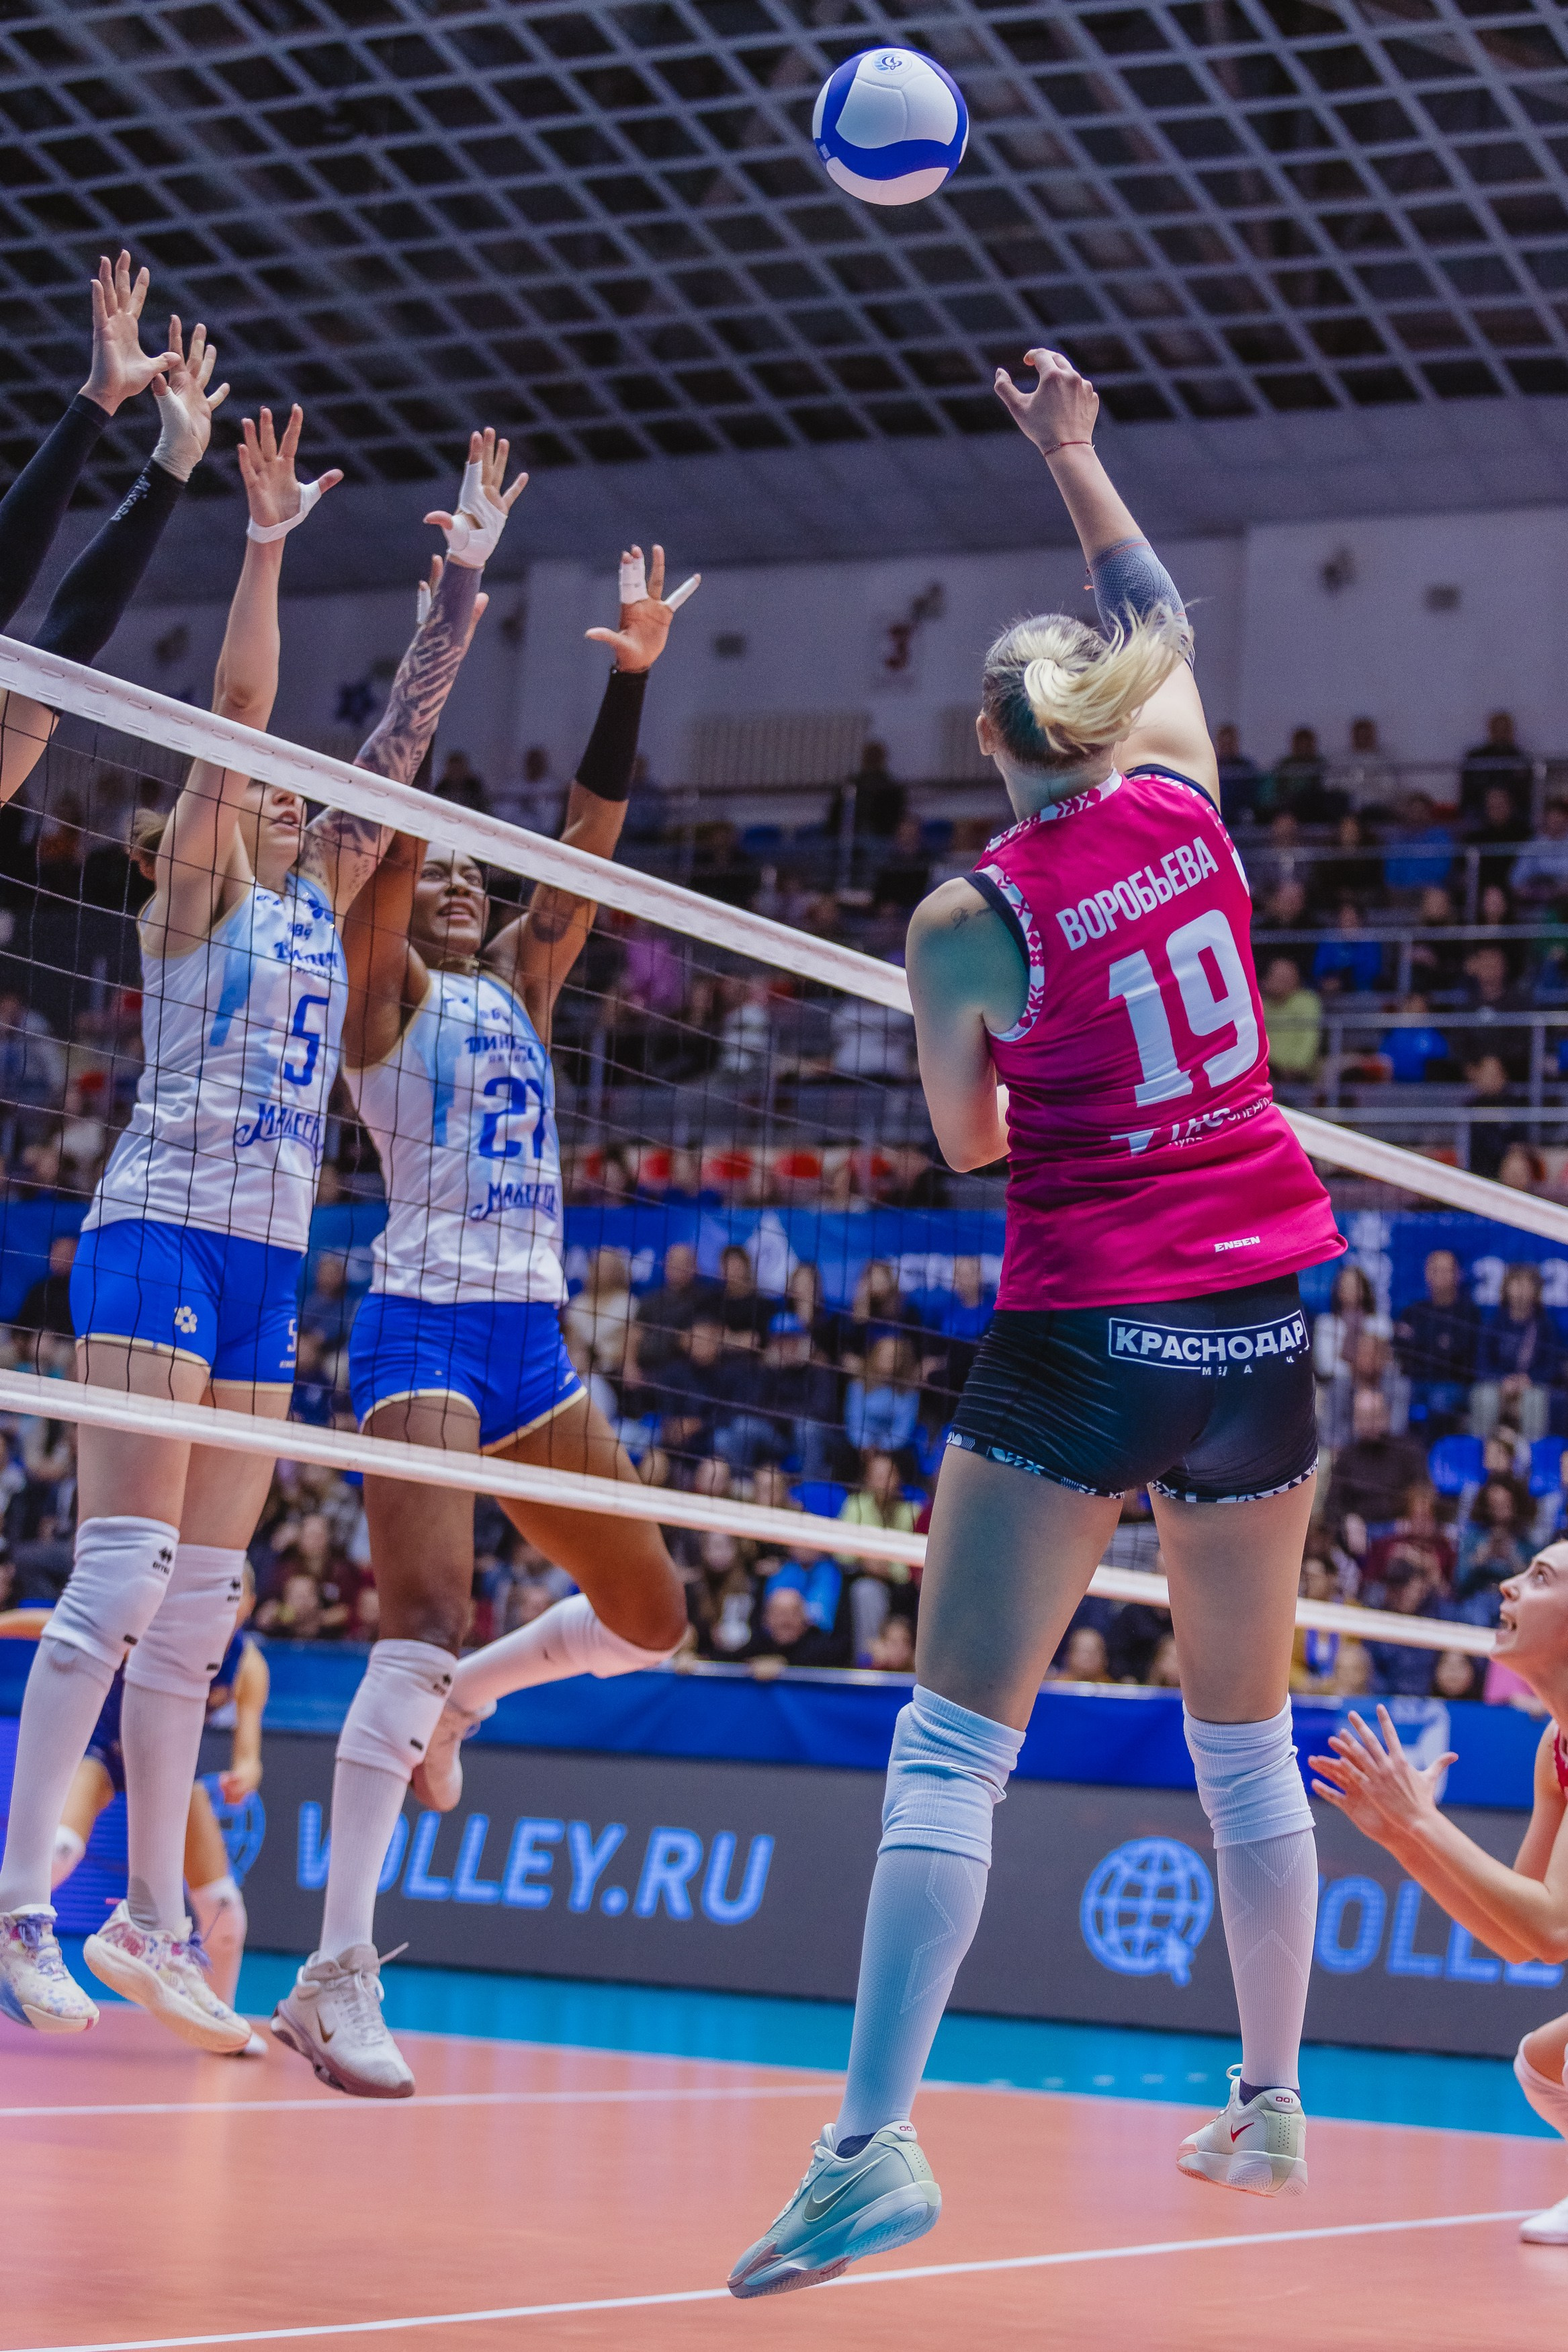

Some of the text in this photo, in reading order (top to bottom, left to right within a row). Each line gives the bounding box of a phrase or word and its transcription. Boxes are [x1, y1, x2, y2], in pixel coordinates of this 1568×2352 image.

[1056, 836, 1219, 951] ВОРОБЬЕВА
[284, 995, 329, 1086] 5
[1108, 909, 1258, 1107] 19
[479, 1077, 545, 1159] 21
[1214, 1236, 1261, 1253] ENSEN
[1115, 1320, 1304, 1361] КРАСНОДАР
